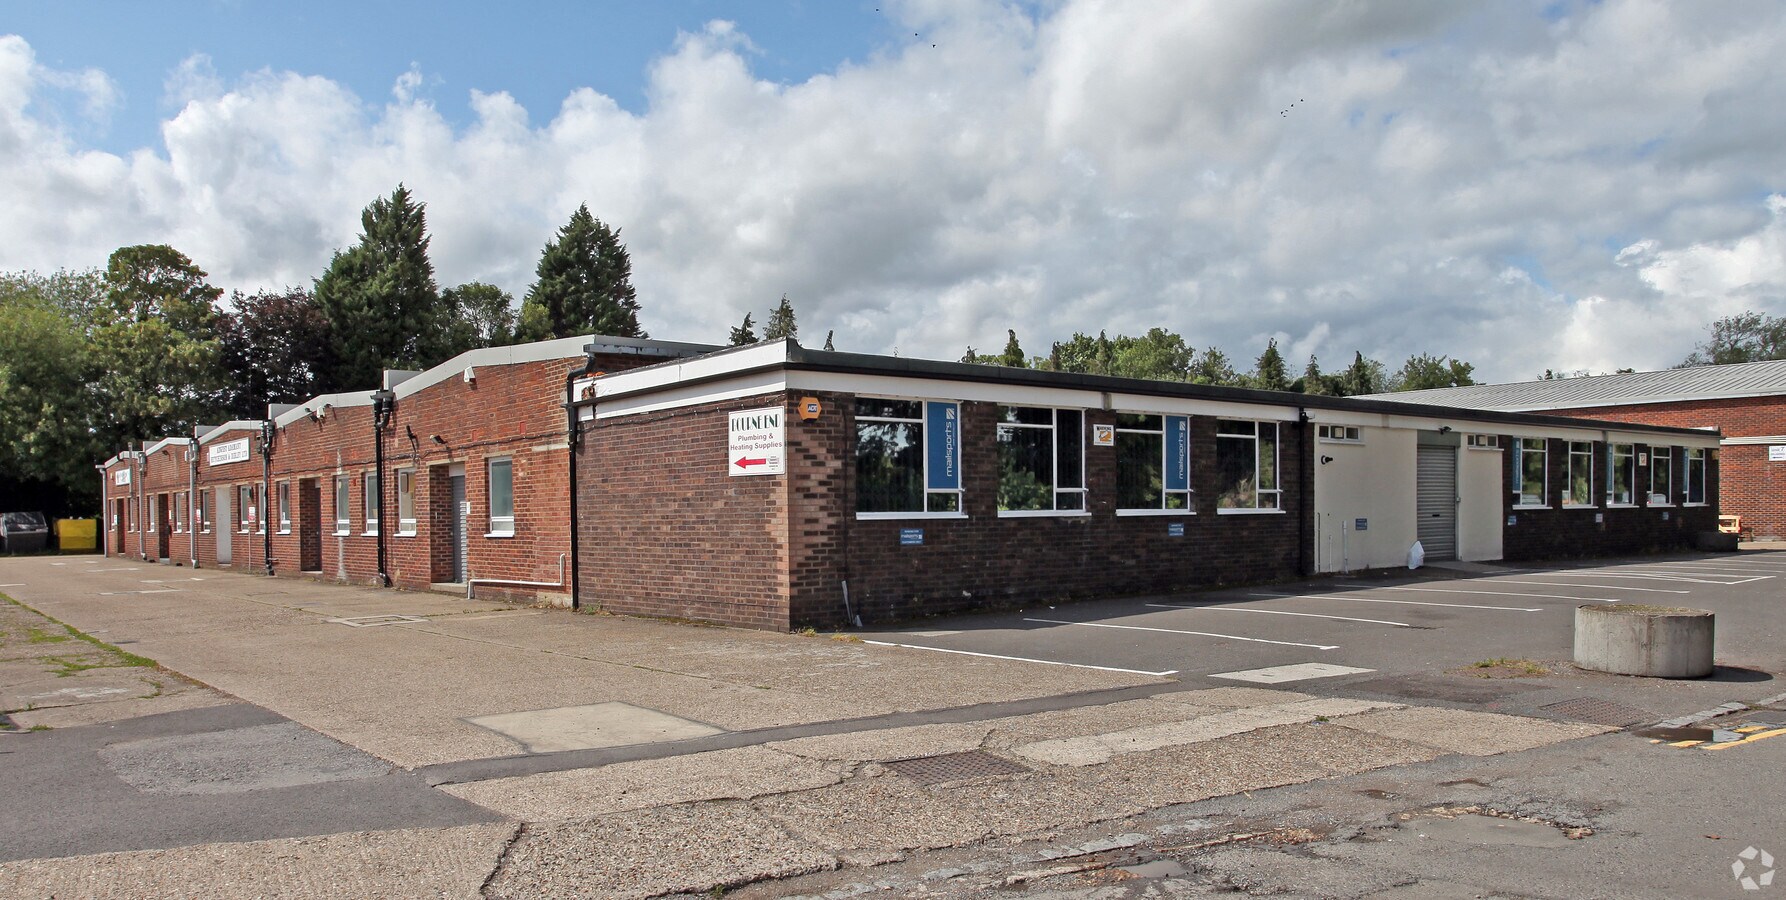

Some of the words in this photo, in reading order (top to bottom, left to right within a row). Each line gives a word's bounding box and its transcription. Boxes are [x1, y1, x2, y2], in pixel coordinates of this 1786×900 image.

[731, 416, 762, 431] BOURNE
[764, 414, 781, 428] END
[945, 421, 953, 476] mailsports
